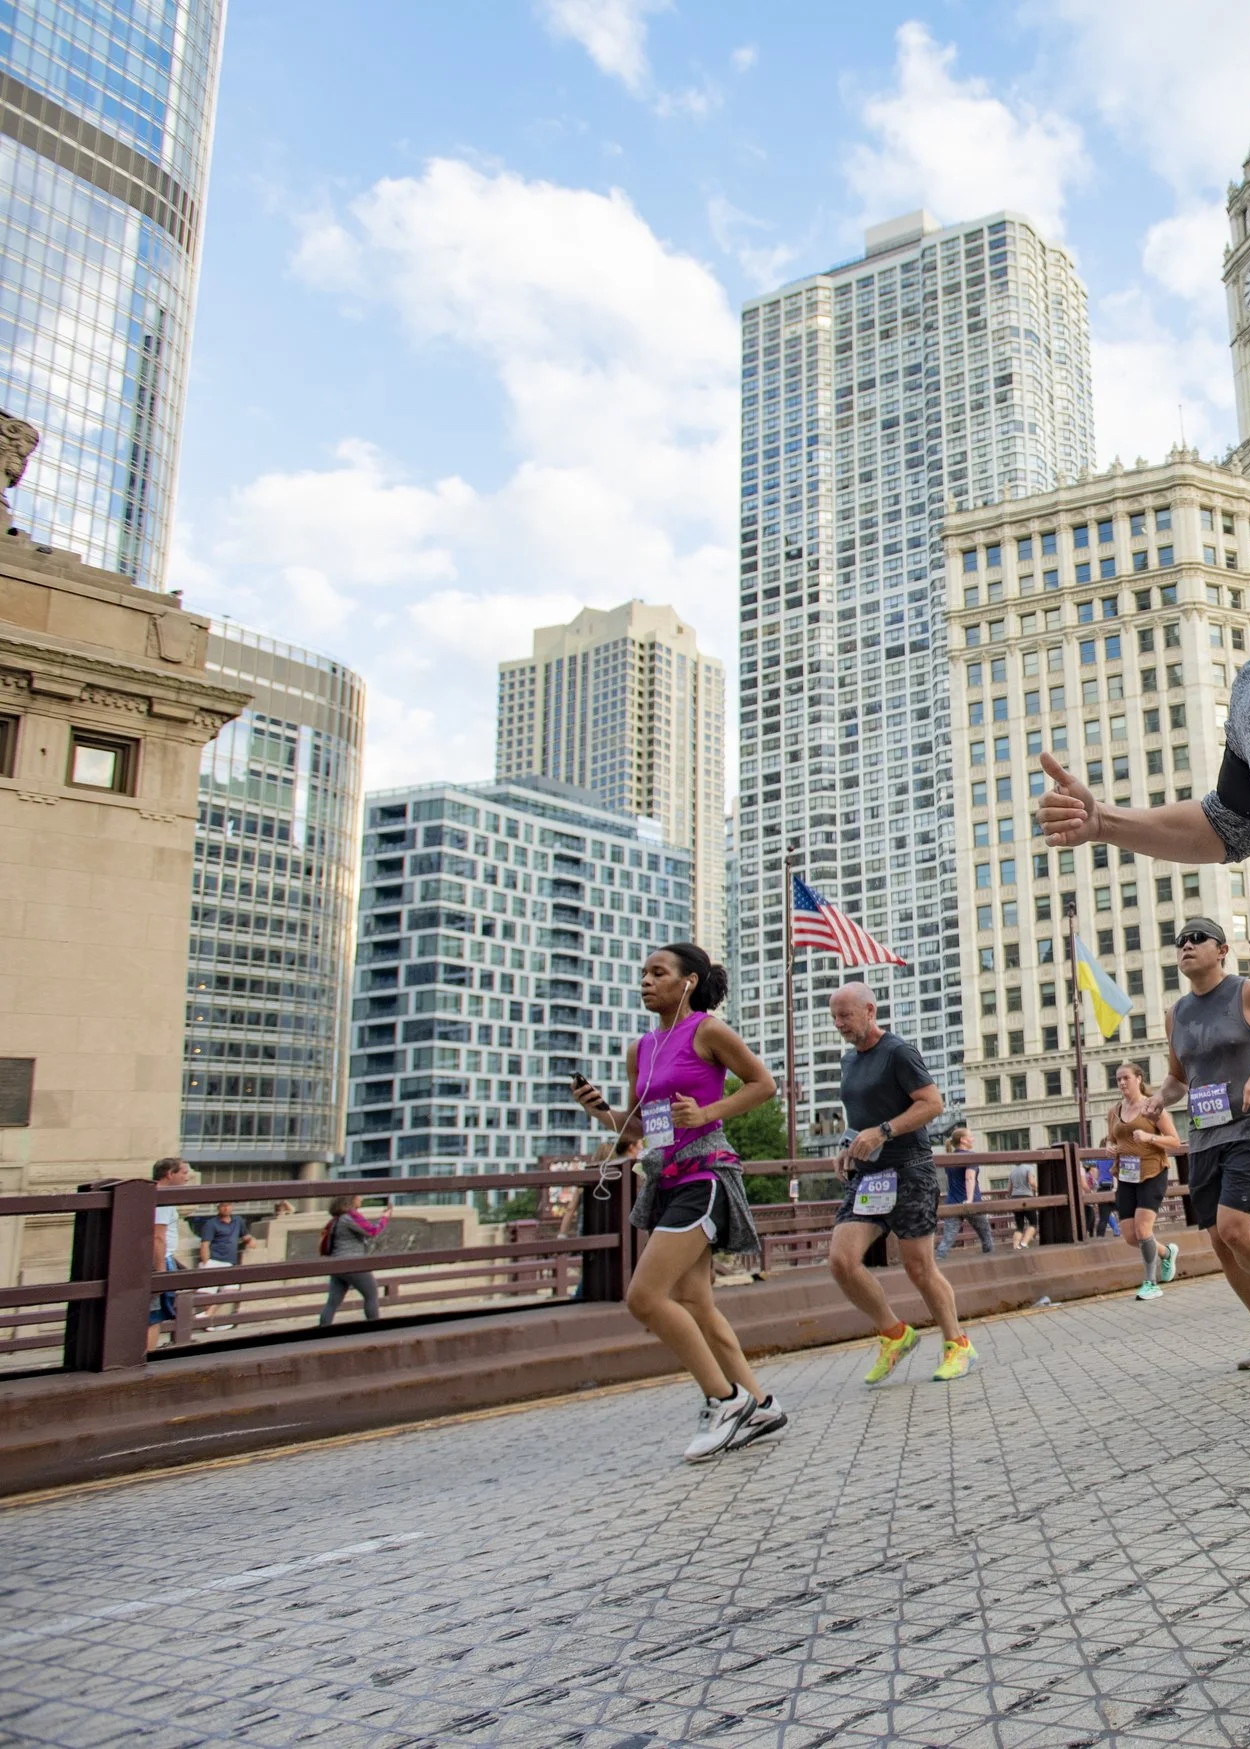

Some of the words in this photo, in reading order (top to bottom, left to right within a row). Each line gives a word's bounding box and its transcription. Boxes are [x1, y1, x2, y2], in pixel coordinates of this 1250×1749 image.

[1197, 1098, 1224, 1113] 1018
[645, 1116, 670, 1133] 1098
[868, 1180, 890, 1192] 609
